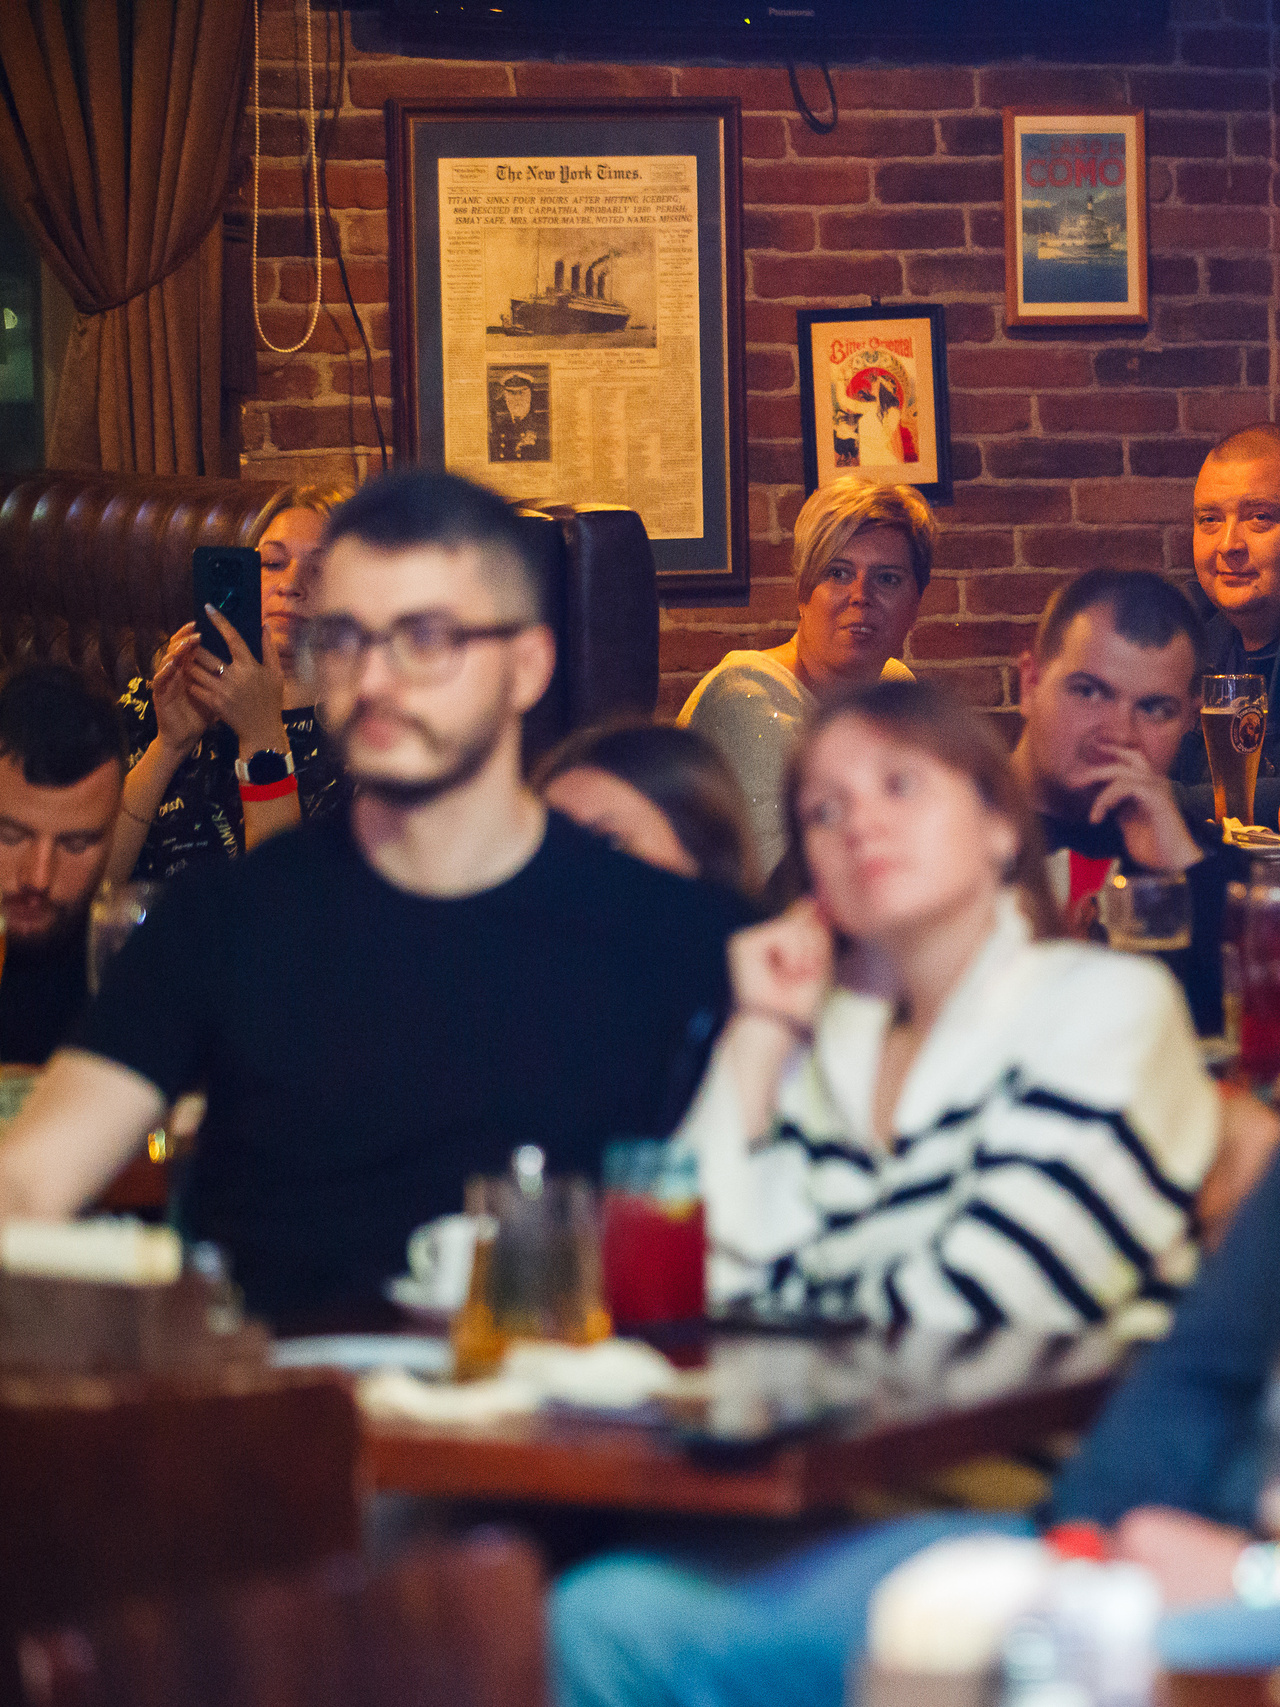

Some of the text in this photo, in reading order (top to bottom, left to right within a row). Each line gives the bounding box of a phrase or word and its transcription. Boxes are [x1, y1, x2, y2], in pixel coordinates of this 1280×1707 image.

[496, 165, 523, 183] The
[526, 165, 556, 181] New
[560, 164, 592, 184] York
[597, 164, 643, 180] Times.
[1026, 158, 1125, 187] COMO
[447, 196, 480, 205] TITANIC
[486, 196, 510, 204] SINKS
[512, 196, 536, 204] FOUR
[540, 195, 569, 204] HOURS
[573, 196, 600, 204] AFTER
[604, 195, 639, 204] HITTING
[584, 206, 629, 214] PROBABLY
[596, 216, 625, 224] NOTED
[627, 215, 657, 223] NAMES
